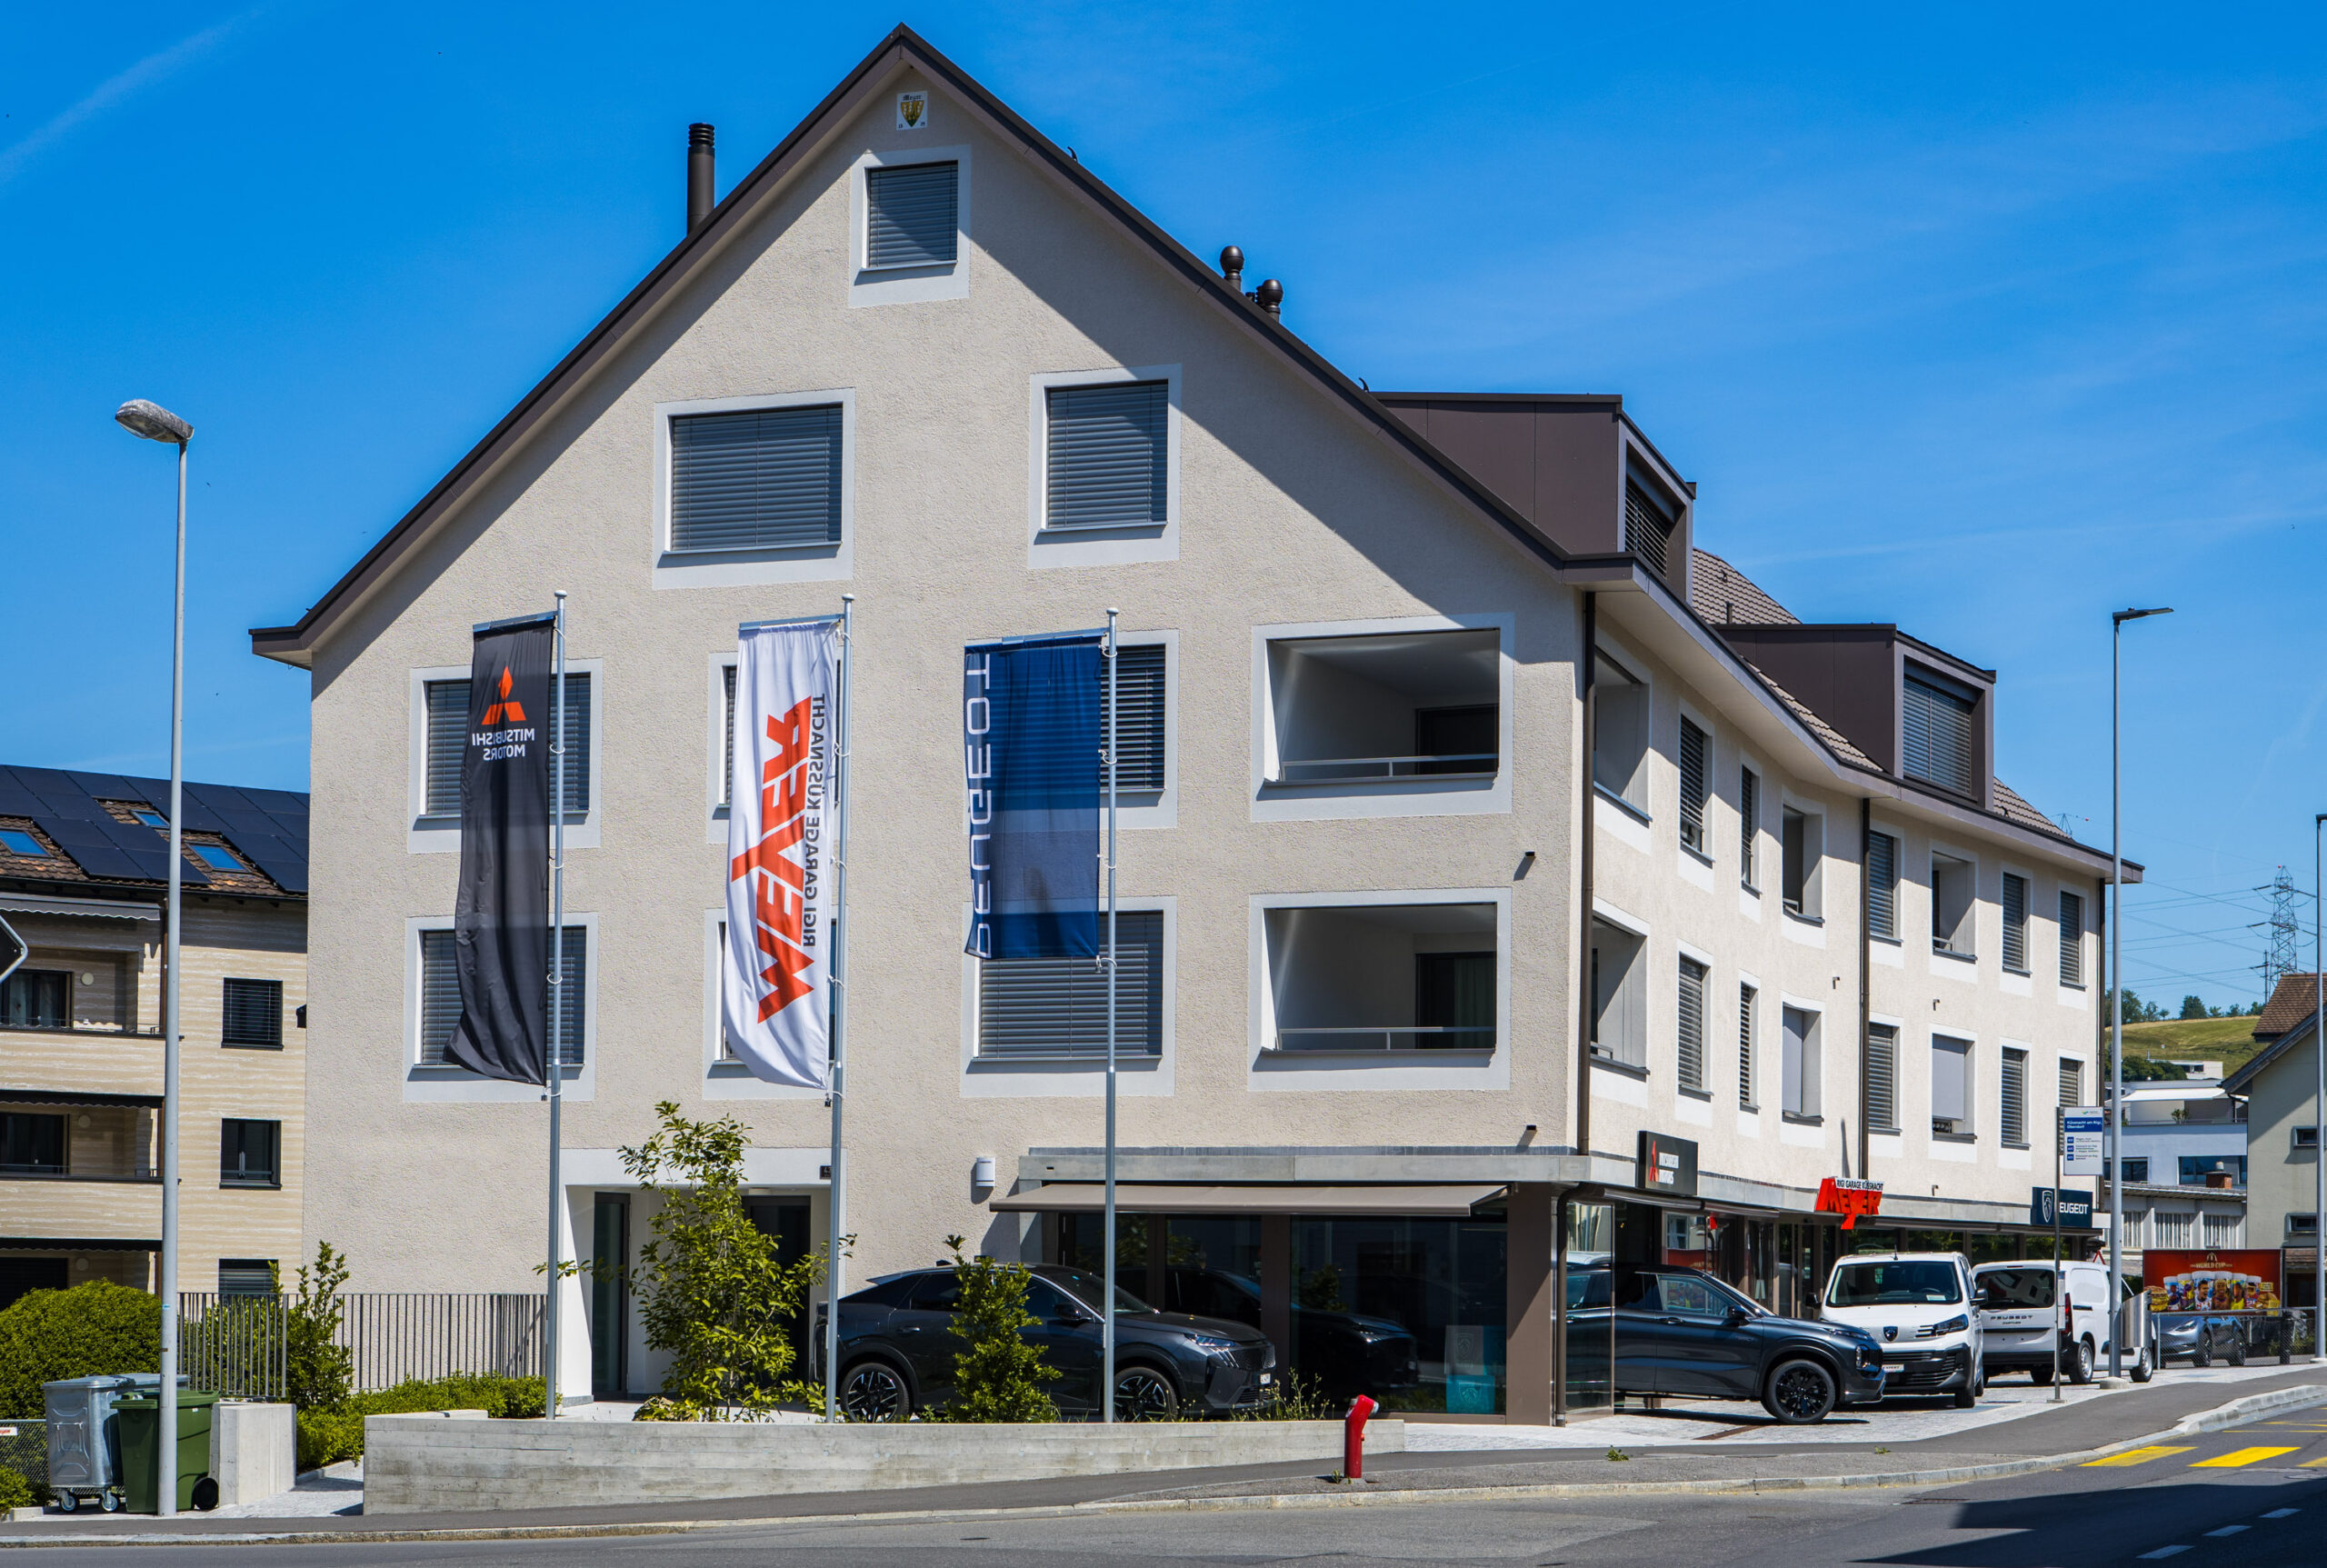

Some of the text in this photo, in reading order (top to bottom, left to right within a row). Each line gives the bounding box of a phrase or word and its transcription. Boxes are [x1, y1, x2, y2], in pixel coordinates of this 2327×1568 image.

[1845, 1180, 1862, 1190] GARAGE
[1815, 1178, 1883, 1230] MEYER
[2058, 1202, 2089, 1214] EUGEOT
